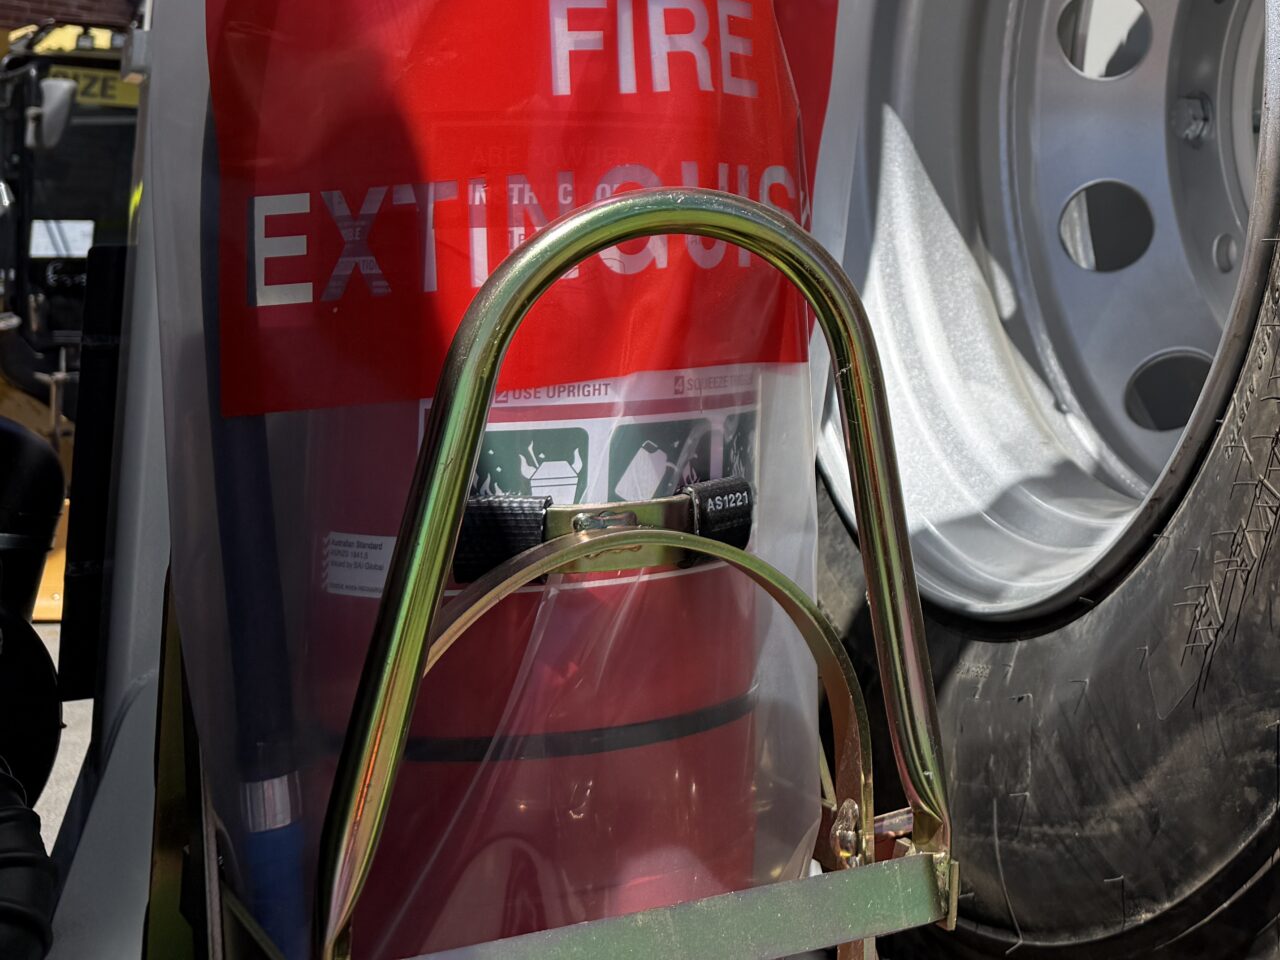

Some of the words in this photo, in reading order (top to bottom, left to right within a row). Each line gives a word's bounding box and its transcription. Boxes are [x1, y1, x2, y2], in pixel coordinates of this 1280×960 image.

[512, 388, 541, 401] USE
[549, 383, 611, 400] UPRIGHT
[687, 375, 728, 392] SQUEEZE
[706, 491, 750, 513] AS1221
